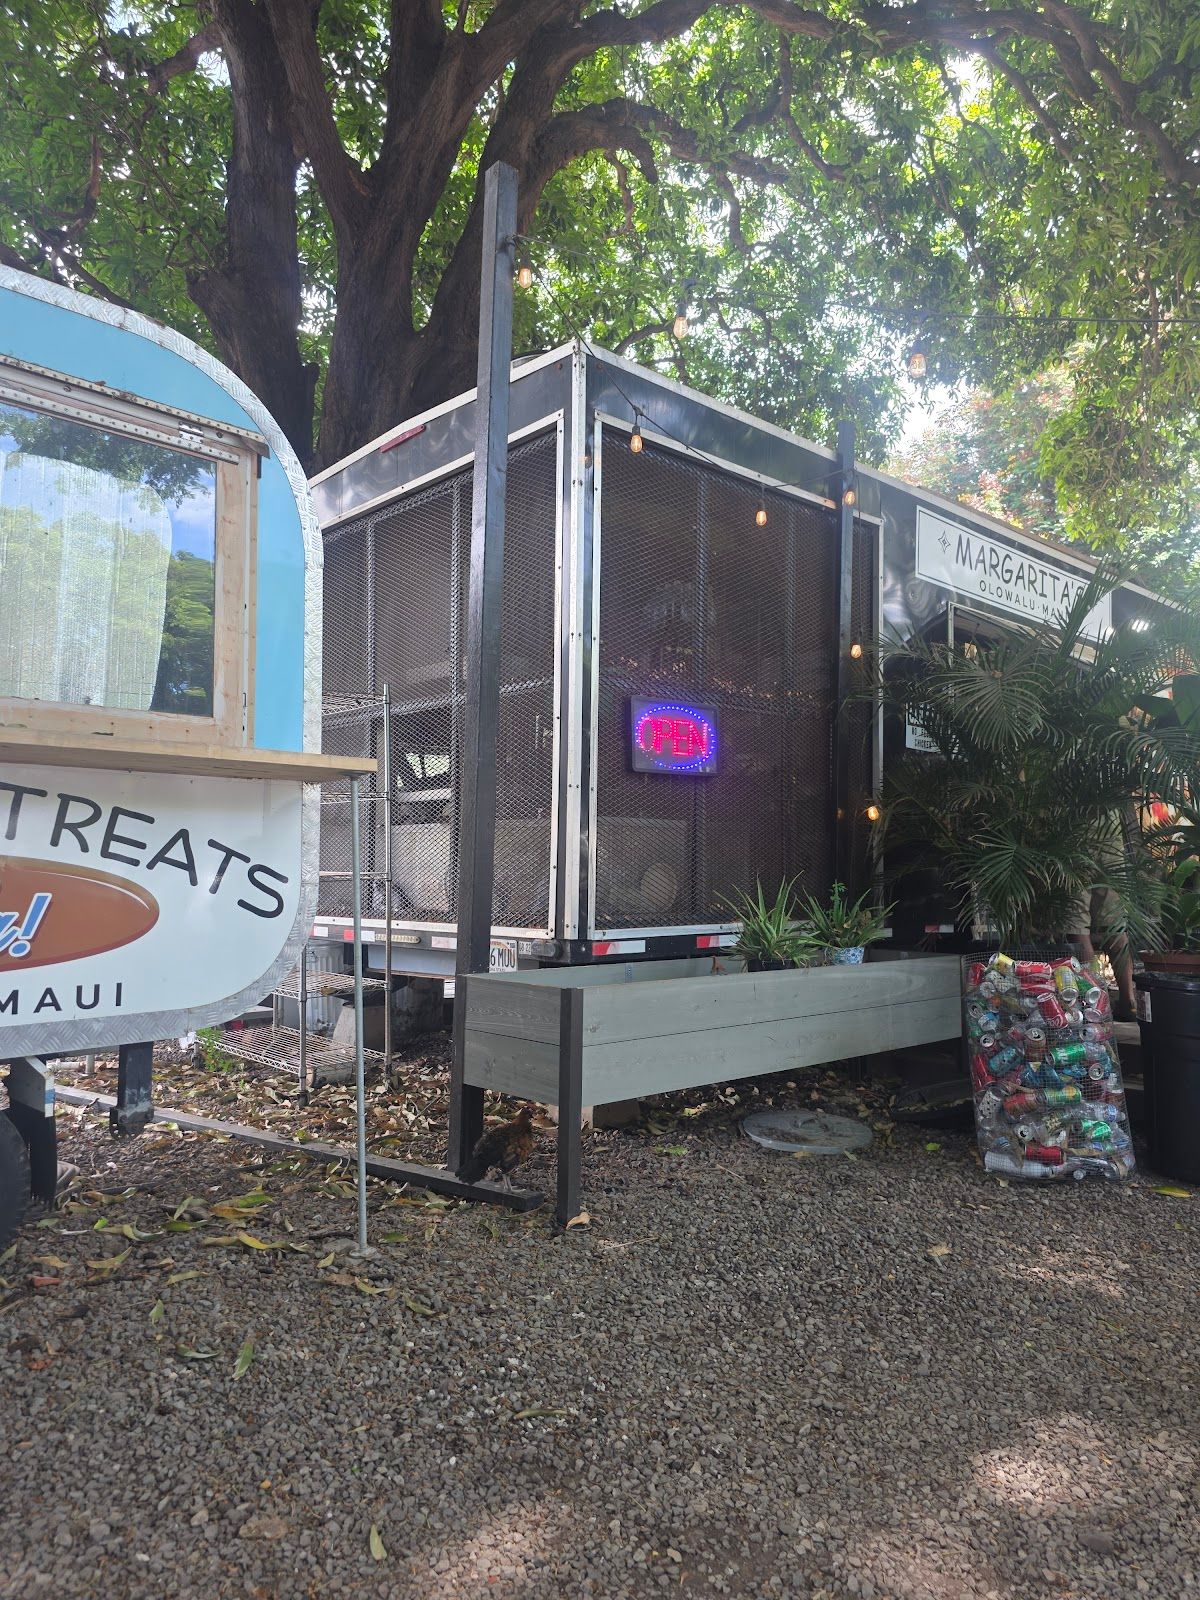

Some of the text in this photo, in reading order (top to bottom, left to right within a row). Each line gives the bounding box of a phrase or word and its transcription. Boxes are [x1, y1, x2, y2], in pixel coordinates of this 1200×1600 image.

[979, 580, 1035, 611] OLOWALU
[638, 716, 709, 758] OPEN
[0, 781, 289, 919] TREATS
[0, 982, 122, 1015] MAUI
